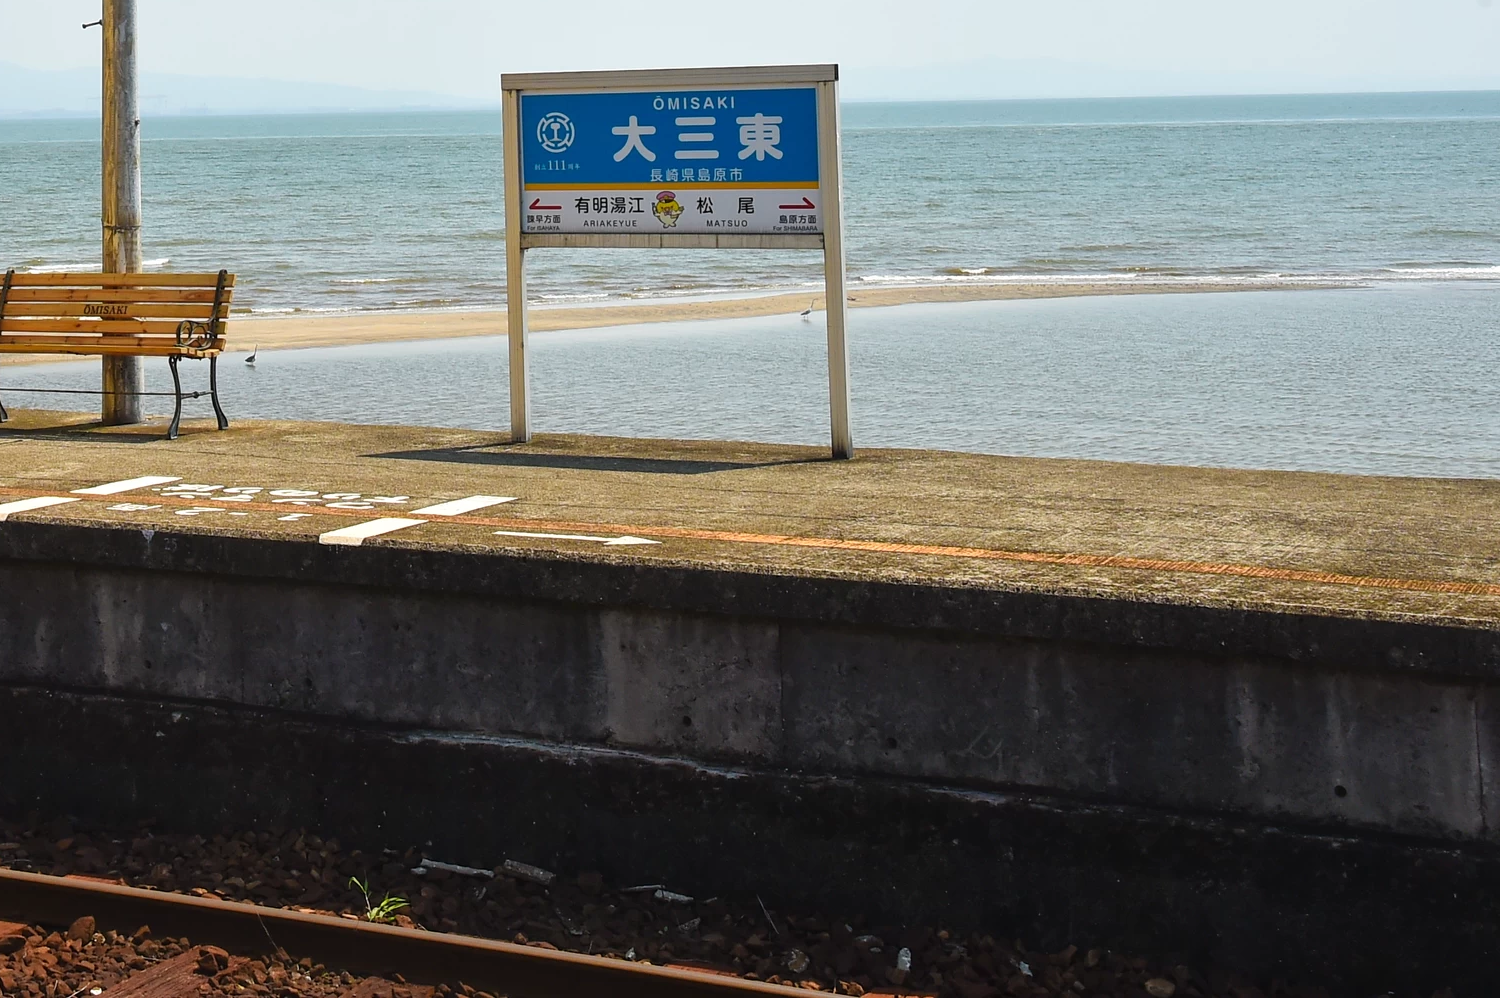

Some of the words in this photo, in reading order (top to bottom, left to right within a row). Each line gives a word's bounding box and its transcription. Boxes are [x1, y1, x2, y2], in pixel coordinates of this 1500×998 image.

[653, 95, 735, 111] ŌMISAKI
[611, 113, 784, 162] 大三東
[650, 167, 743, 182] 長崎県島原市
[574, 196, 645, 214] 有明湯江
[696, 196, 755, 214] 松尾
[583, 219, 638, 228] ARIAKEYUE
[706, 219, 748, 228] MATSUO
[779, 214, 817, 224] 島原方面
